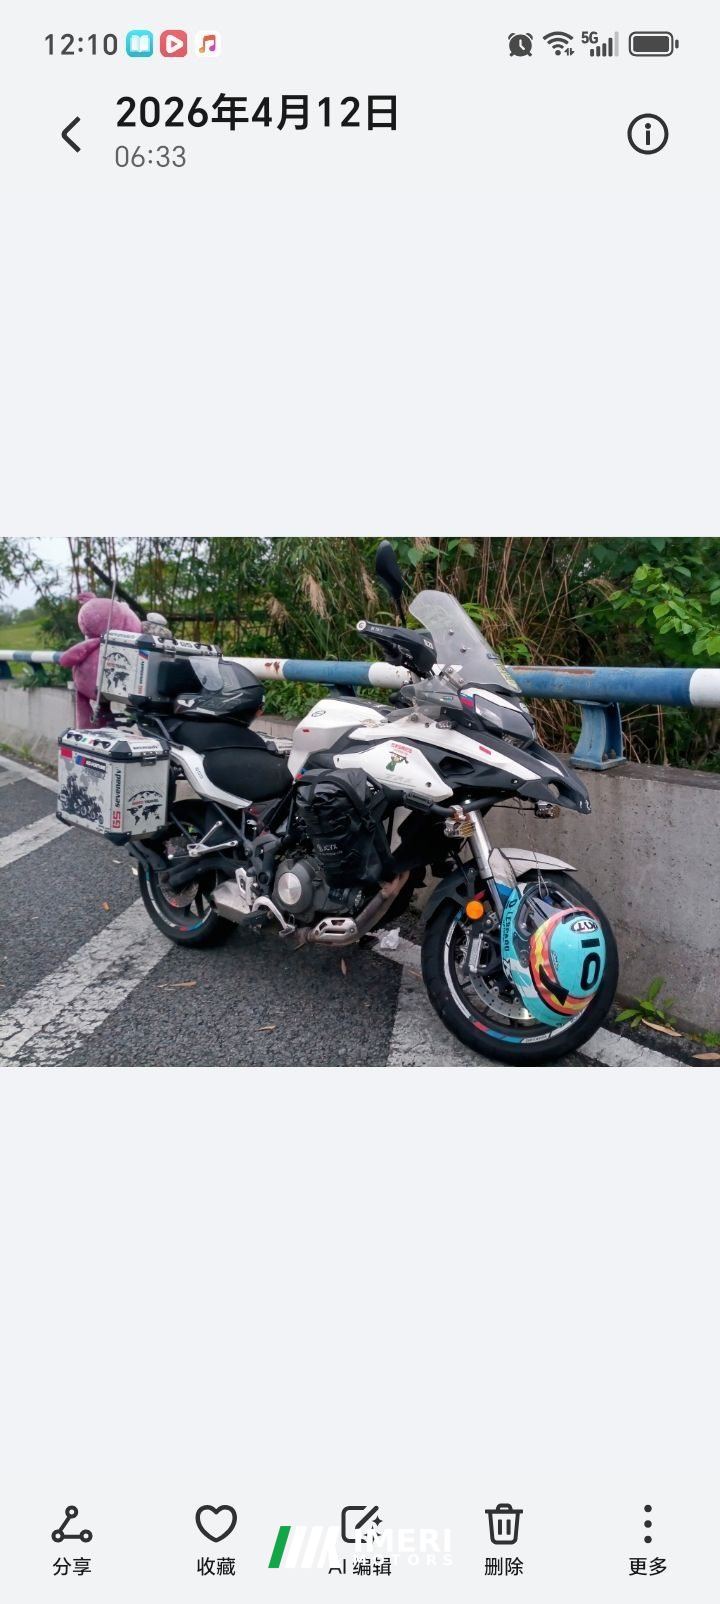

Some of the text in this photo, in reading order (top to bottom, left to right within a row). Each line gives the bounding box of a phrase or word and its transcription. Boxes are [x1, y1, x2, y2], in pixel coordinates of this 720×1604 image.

[44, 33, 117, 56] 12:10
[581, 31, 599, 44] 5G
[116, 93, 397, 132] 2026年4月12日
[115, 145, 187, 168] 06:33
[52, 1556, 92, 1577] 分享
[196, 1556, 236, 1577] 收藏
[328, 1556, 391, 1577] AI 编辑
[484, 1556, 524, 1577] 删除
[628, 1556, 668, 1577] 更多
